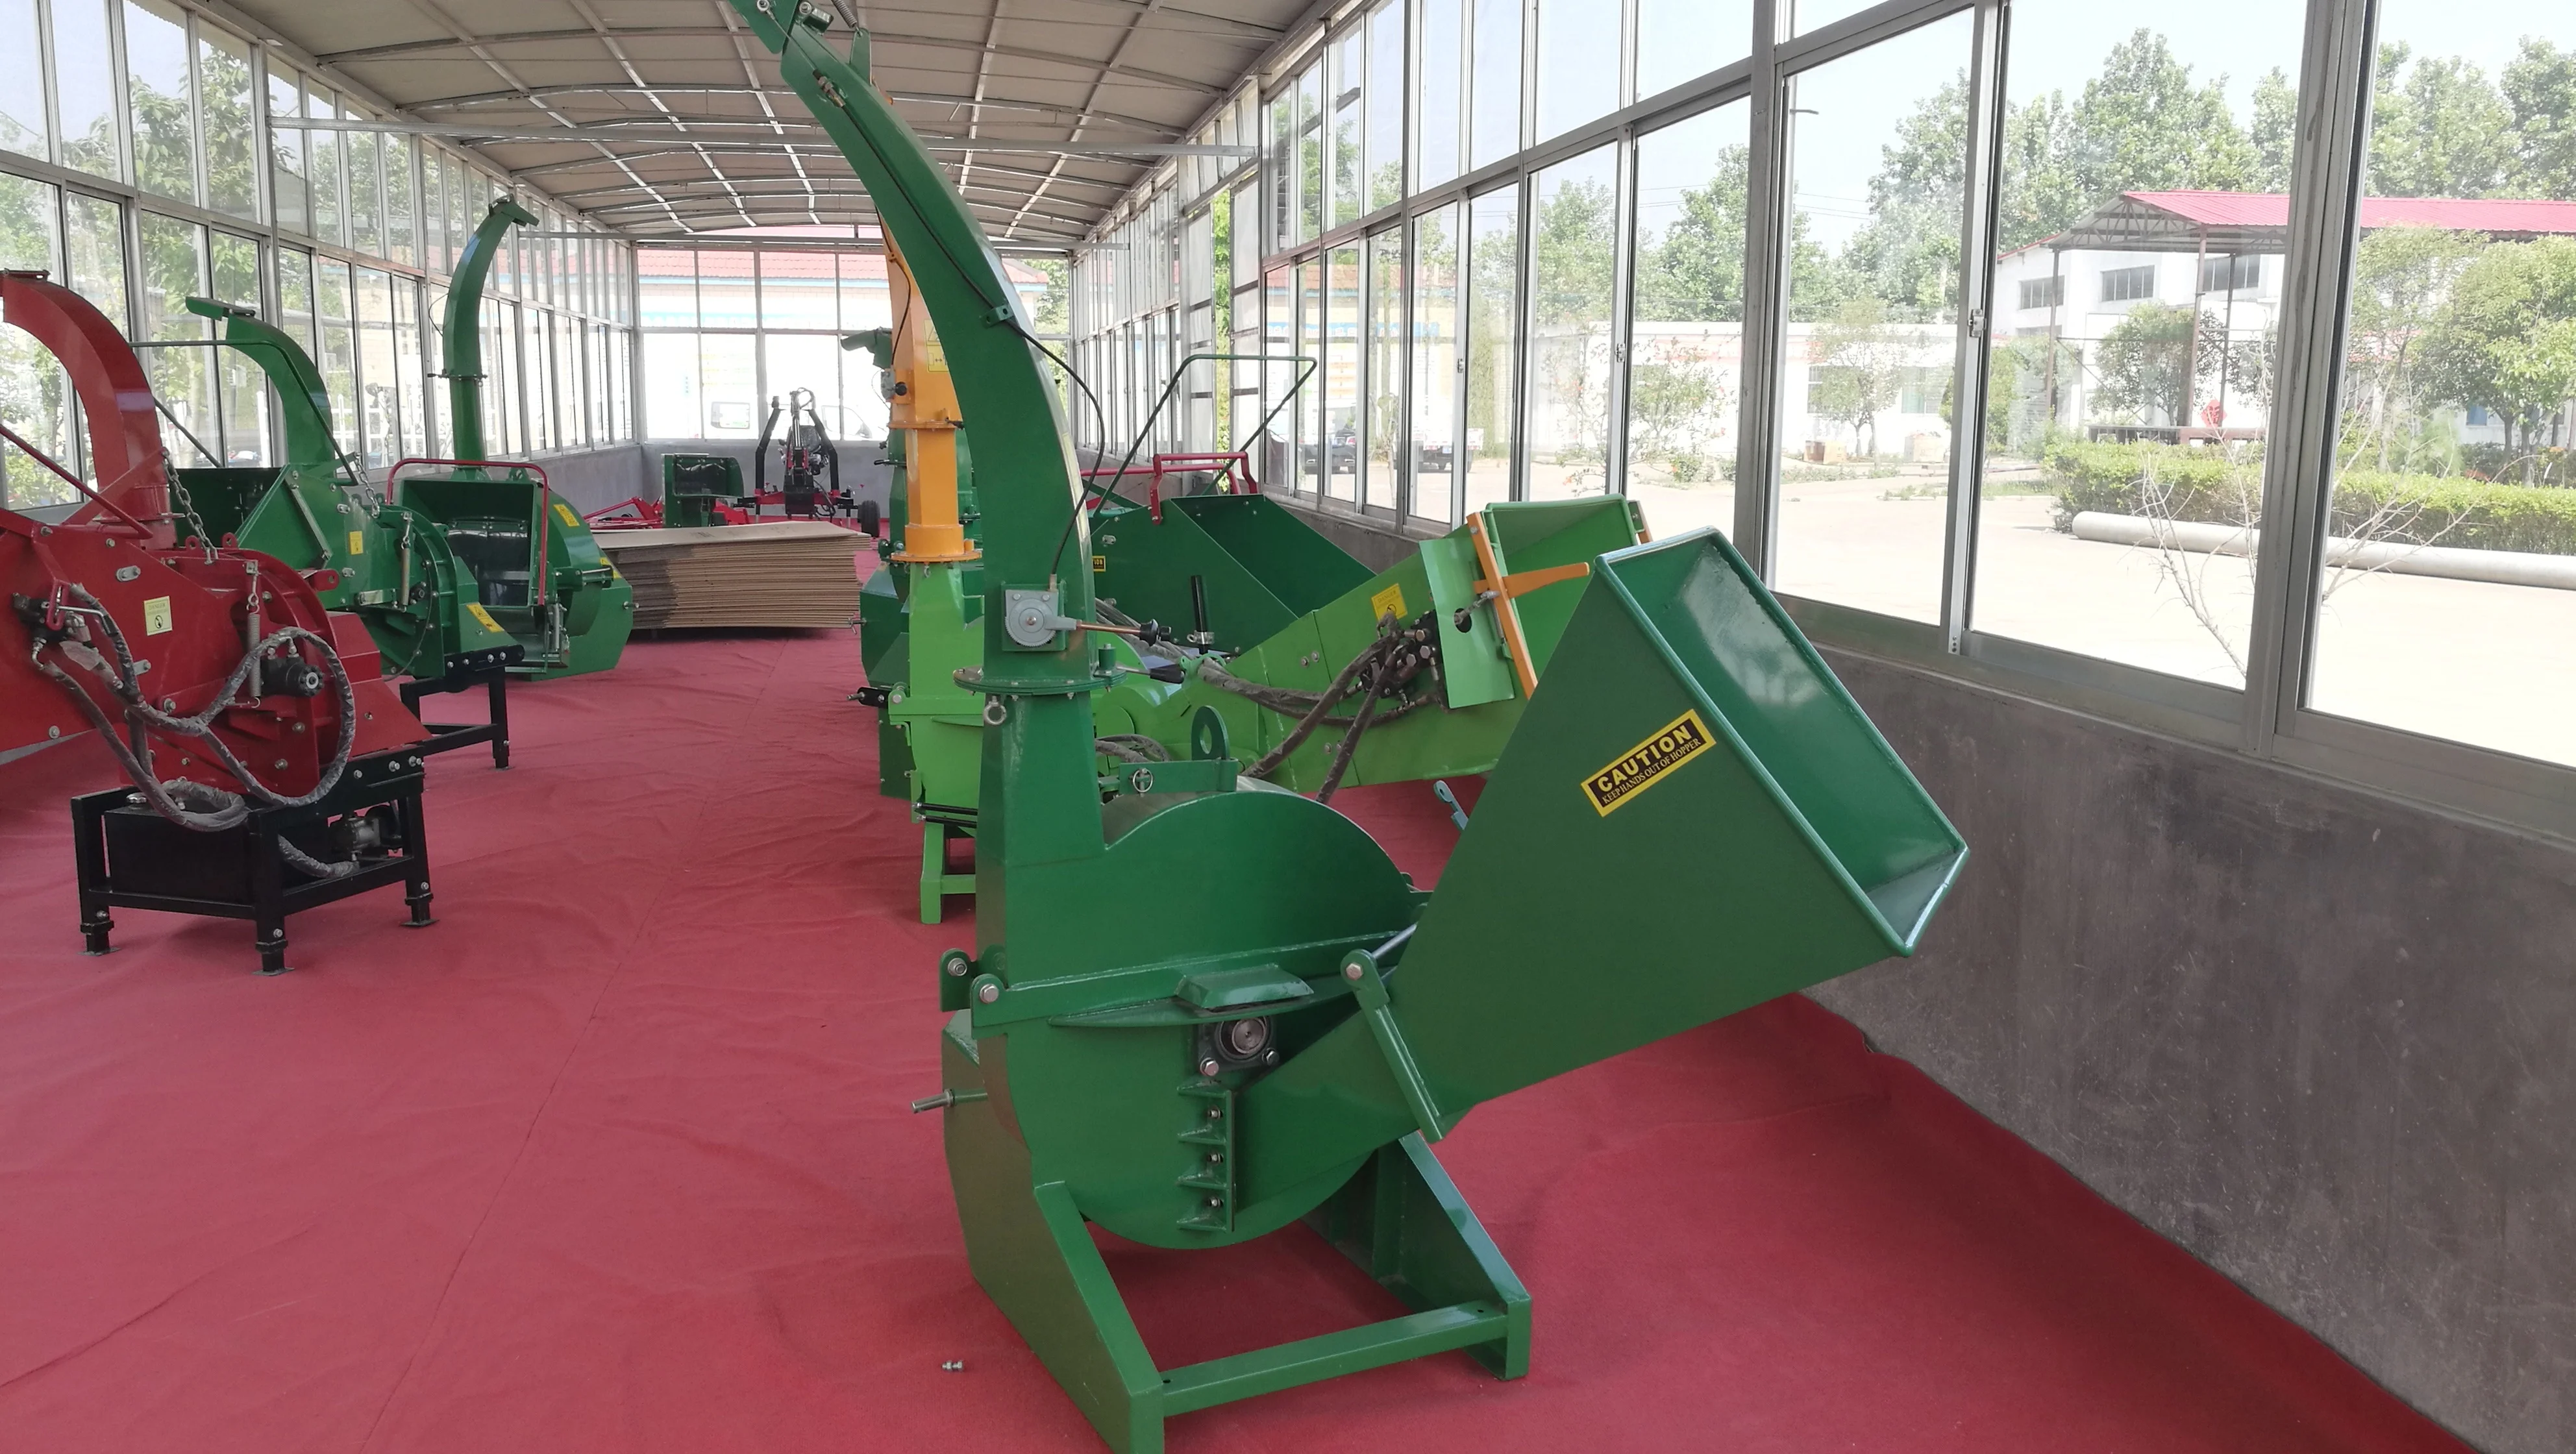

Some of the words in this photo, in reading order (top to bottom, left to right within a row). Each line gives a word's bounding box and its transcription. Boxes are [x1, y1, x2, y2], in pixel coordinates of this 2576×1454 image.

[1598, 725, 1692, 792] CAUTION
[1602, 788, 1620, 804] KEEP
[1620, 772, 1646, 793] HANDS
[1644, 763, 1661, 777] OUT
[1660, 756, 1670, 767] OF
[1670, 738, 1701, 761] HOPPER
